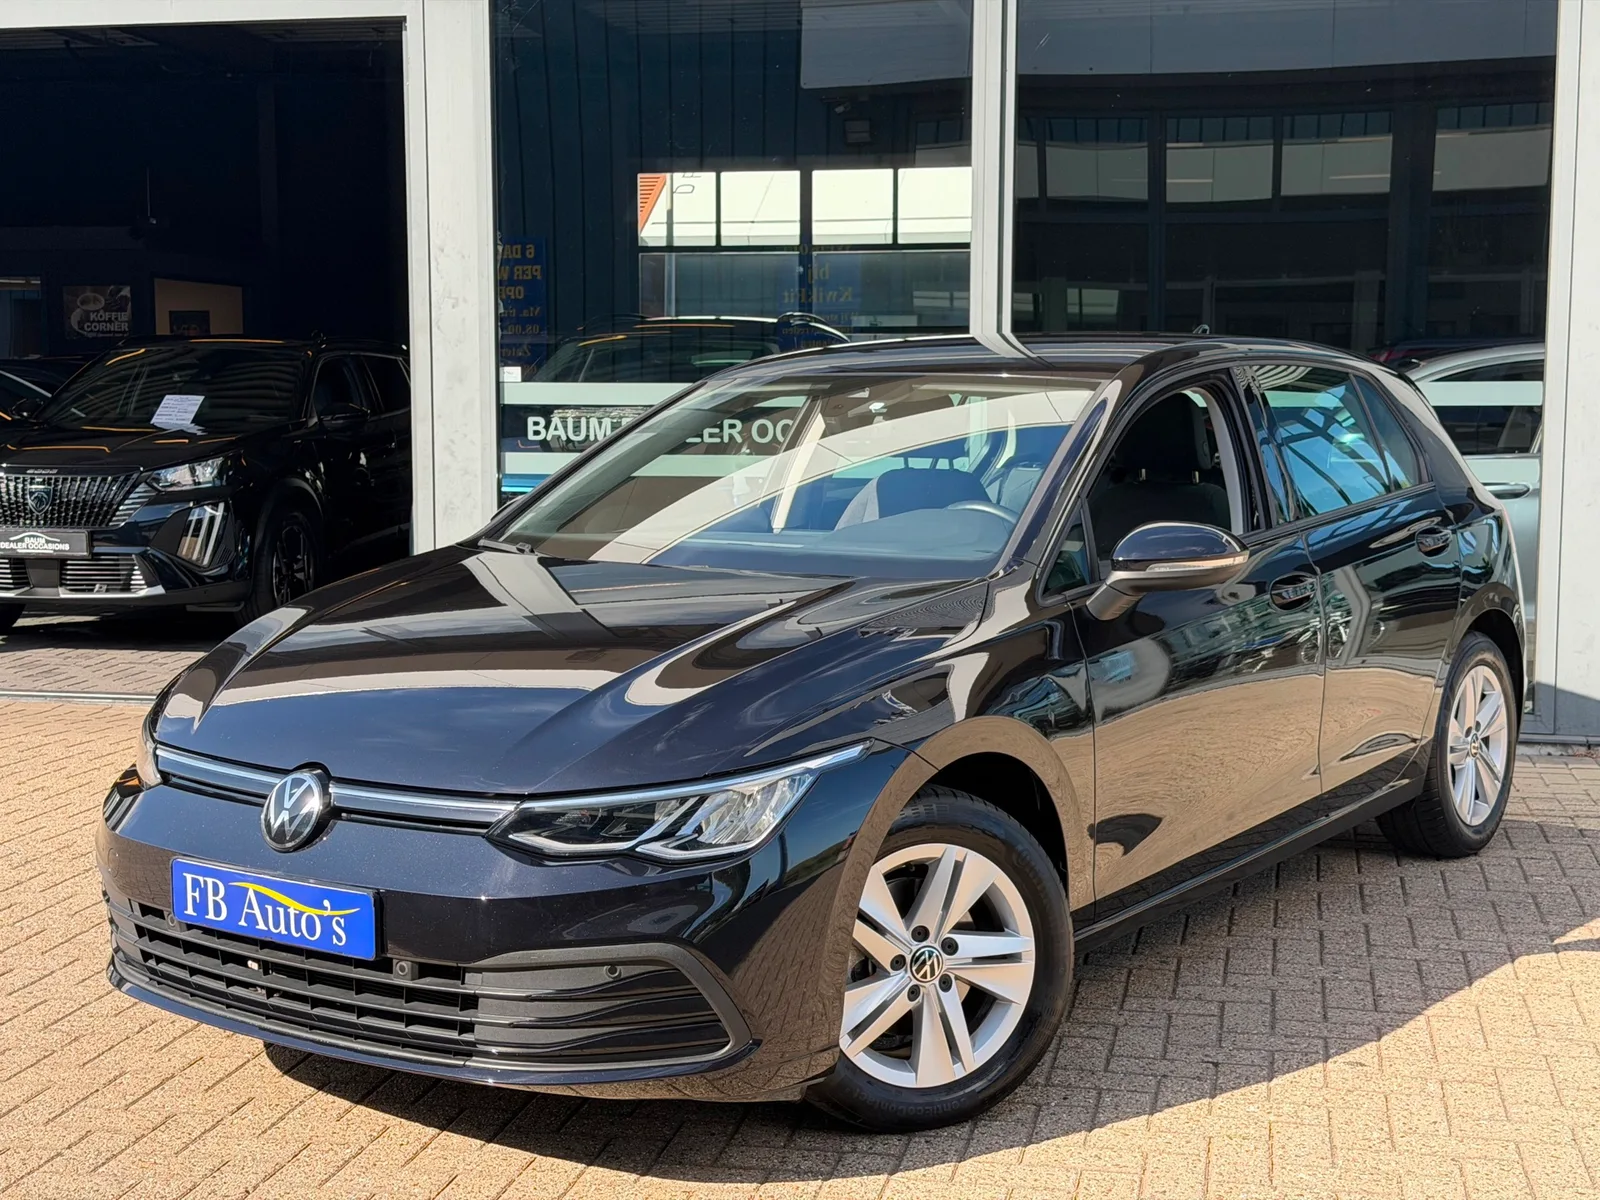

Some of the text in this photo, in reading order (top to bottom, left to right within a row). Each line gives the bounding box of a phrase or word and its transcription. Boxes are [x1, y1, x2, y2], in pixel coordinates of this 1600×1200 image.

[90, 311, 129, 321] KOFFIE
[84, 322, 129, 332] CORNER
[527, 416, 612, 441] BAUM
[24, 536, 46, 544] BAUM
[0, 541, 70, 551] DEALER OCCASIONS
[182, 872, 347, 946] FB Auto's
